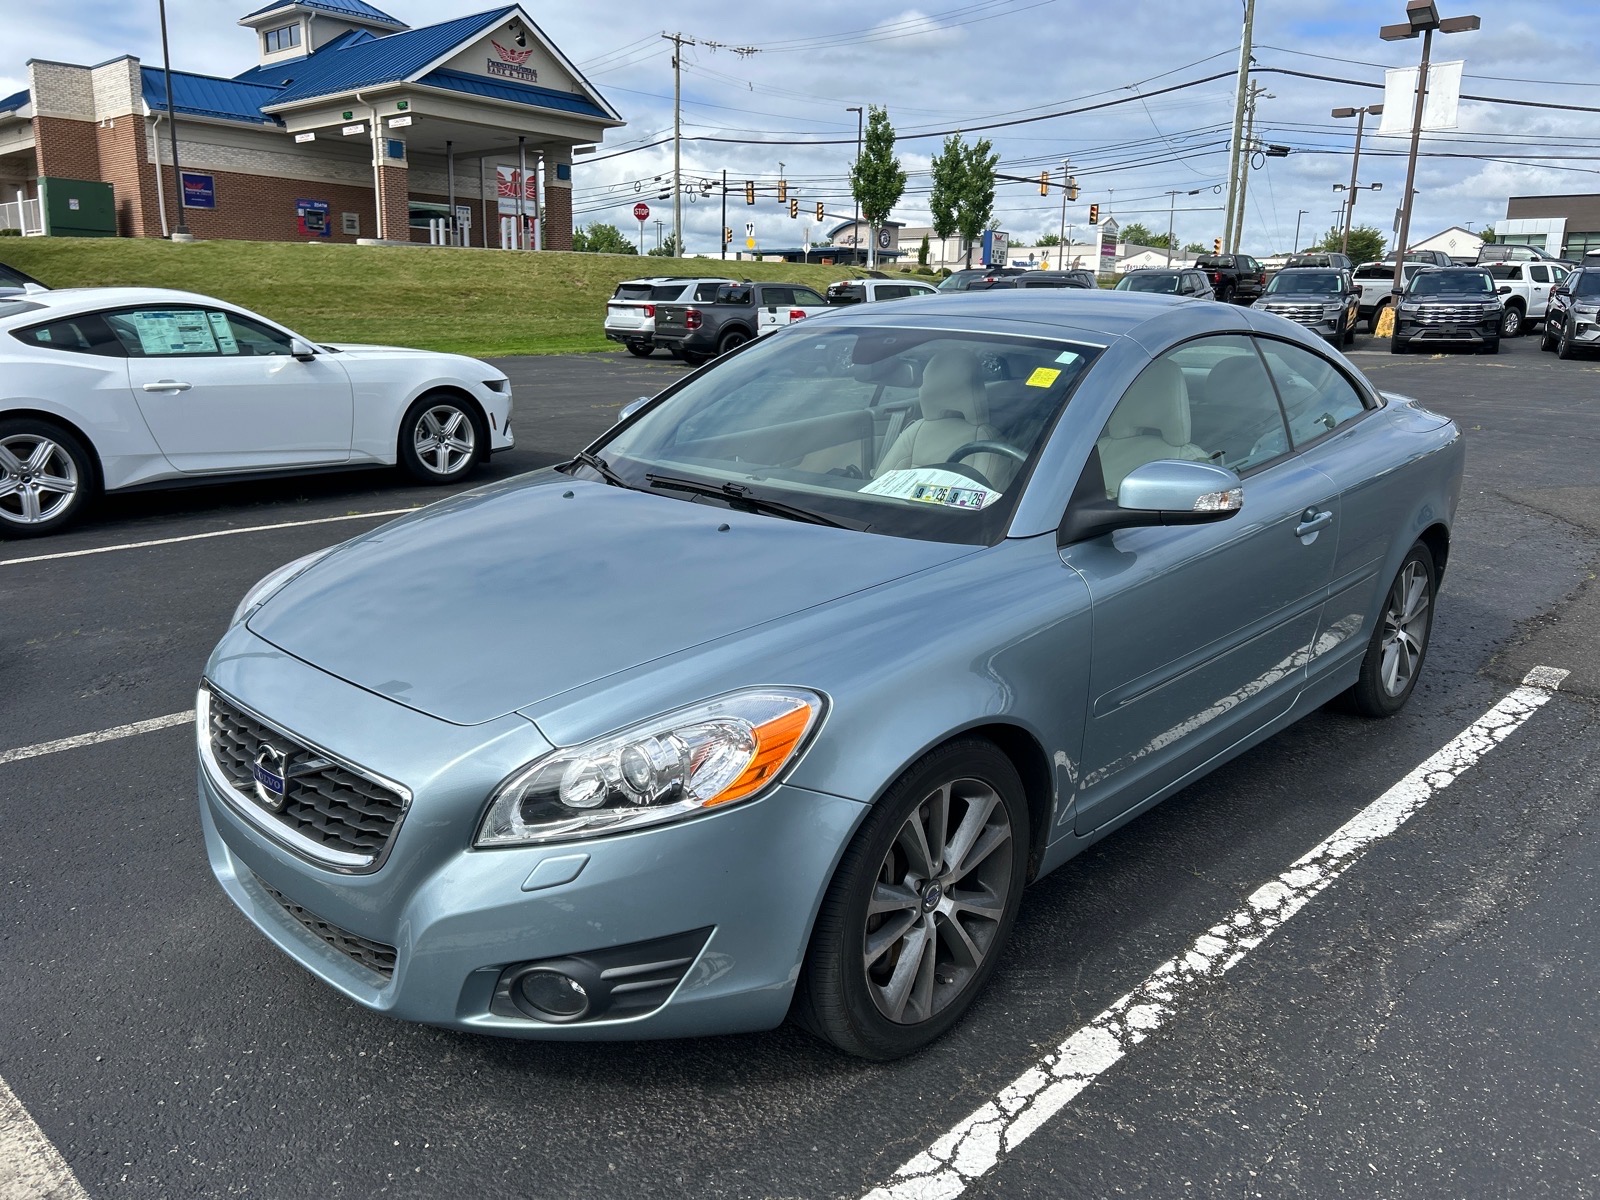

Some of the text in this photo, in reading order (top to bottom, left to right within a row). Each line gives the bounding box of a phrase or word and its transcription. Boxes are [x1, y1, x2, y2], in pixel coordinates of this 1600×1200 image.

[487, 65, 506, 76] BANK
[516, 71, 538, 83] TRUST
[635, 208, 649, 216] STOP
[917, 487, 948, 501] 9 26
[951, 492, 983, 506] 9 26
[255, 767, 281, 790] VOLVO
